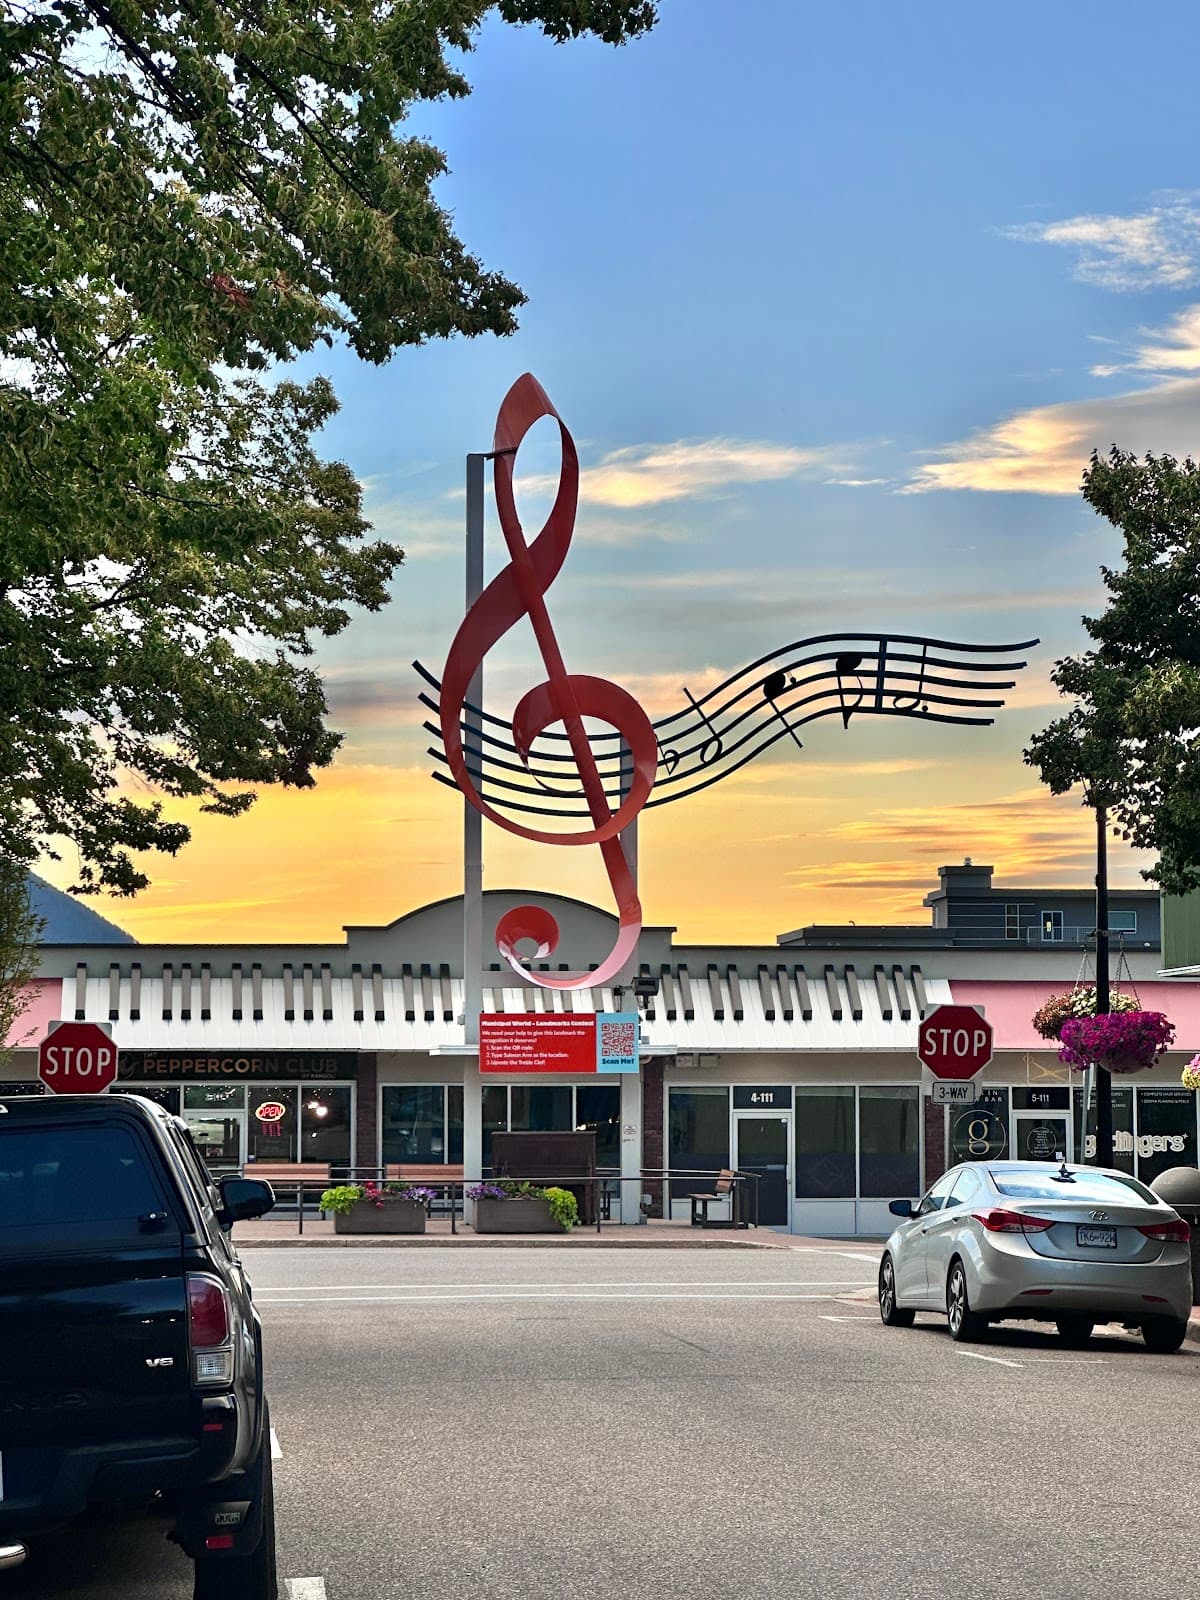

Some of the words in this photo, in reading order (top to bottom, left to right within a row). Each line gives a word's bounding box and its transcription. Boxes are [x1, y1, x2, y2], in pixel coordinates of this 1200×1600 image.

[925, 1028, 987, 1057] STOP
[46, 1046, 112, 1076] STOP
[144, 1058, 279, 1073] PEPPERCORN
[286, 1058, 338, 1072] CLUB
[750, 1092, 774, 1103] 4-111
[939, 1087, 968, 1098] 3-WAY
[1032, 1094, 1050, 1102] 5-111
[260, 1106, 282, 1117] OPEN
